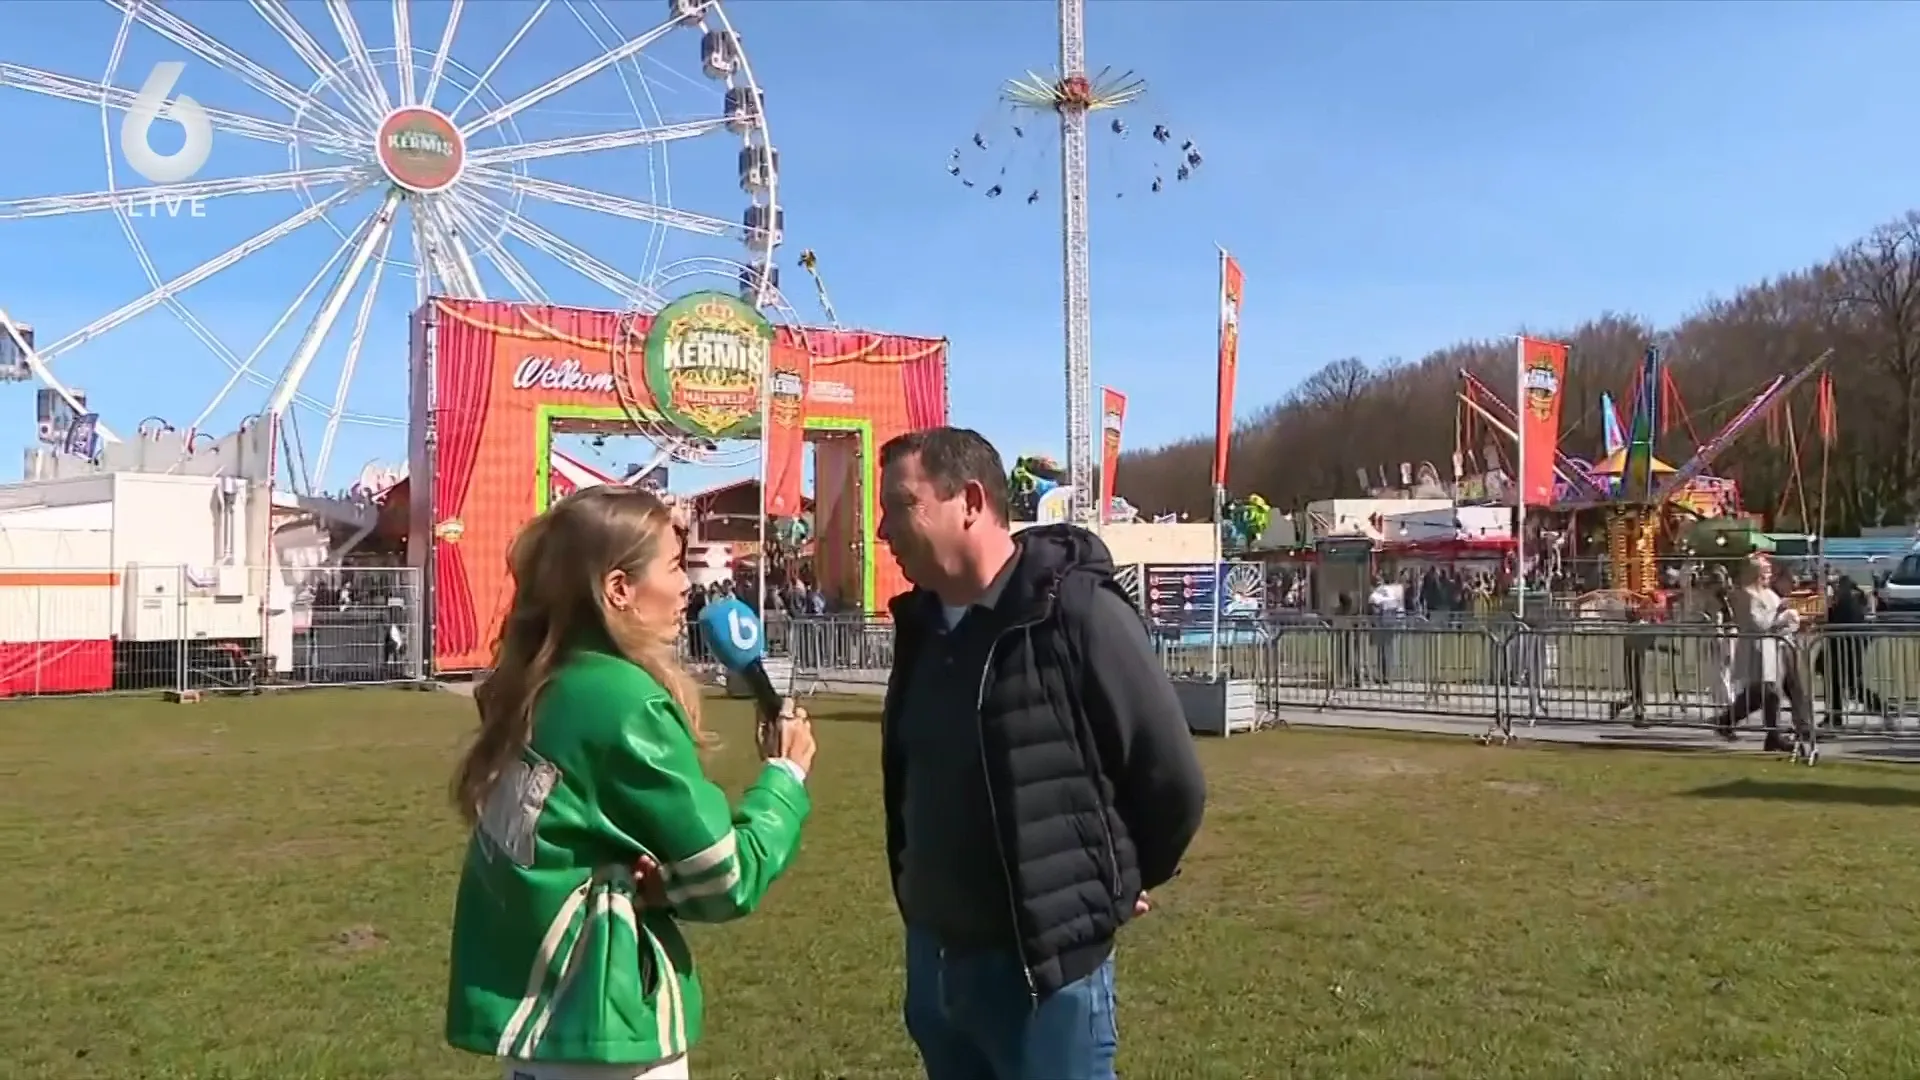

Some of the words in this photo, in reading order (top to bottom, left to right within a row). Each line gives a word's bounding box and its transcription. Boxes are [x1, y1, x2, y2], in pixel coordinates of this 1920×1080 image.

[387, 132, 454, 158] KERMIS
[513, 355, 615, 392] Welkom
[663, 337, 763, 375] KERMIS
[728, 608, 758, 650] b
